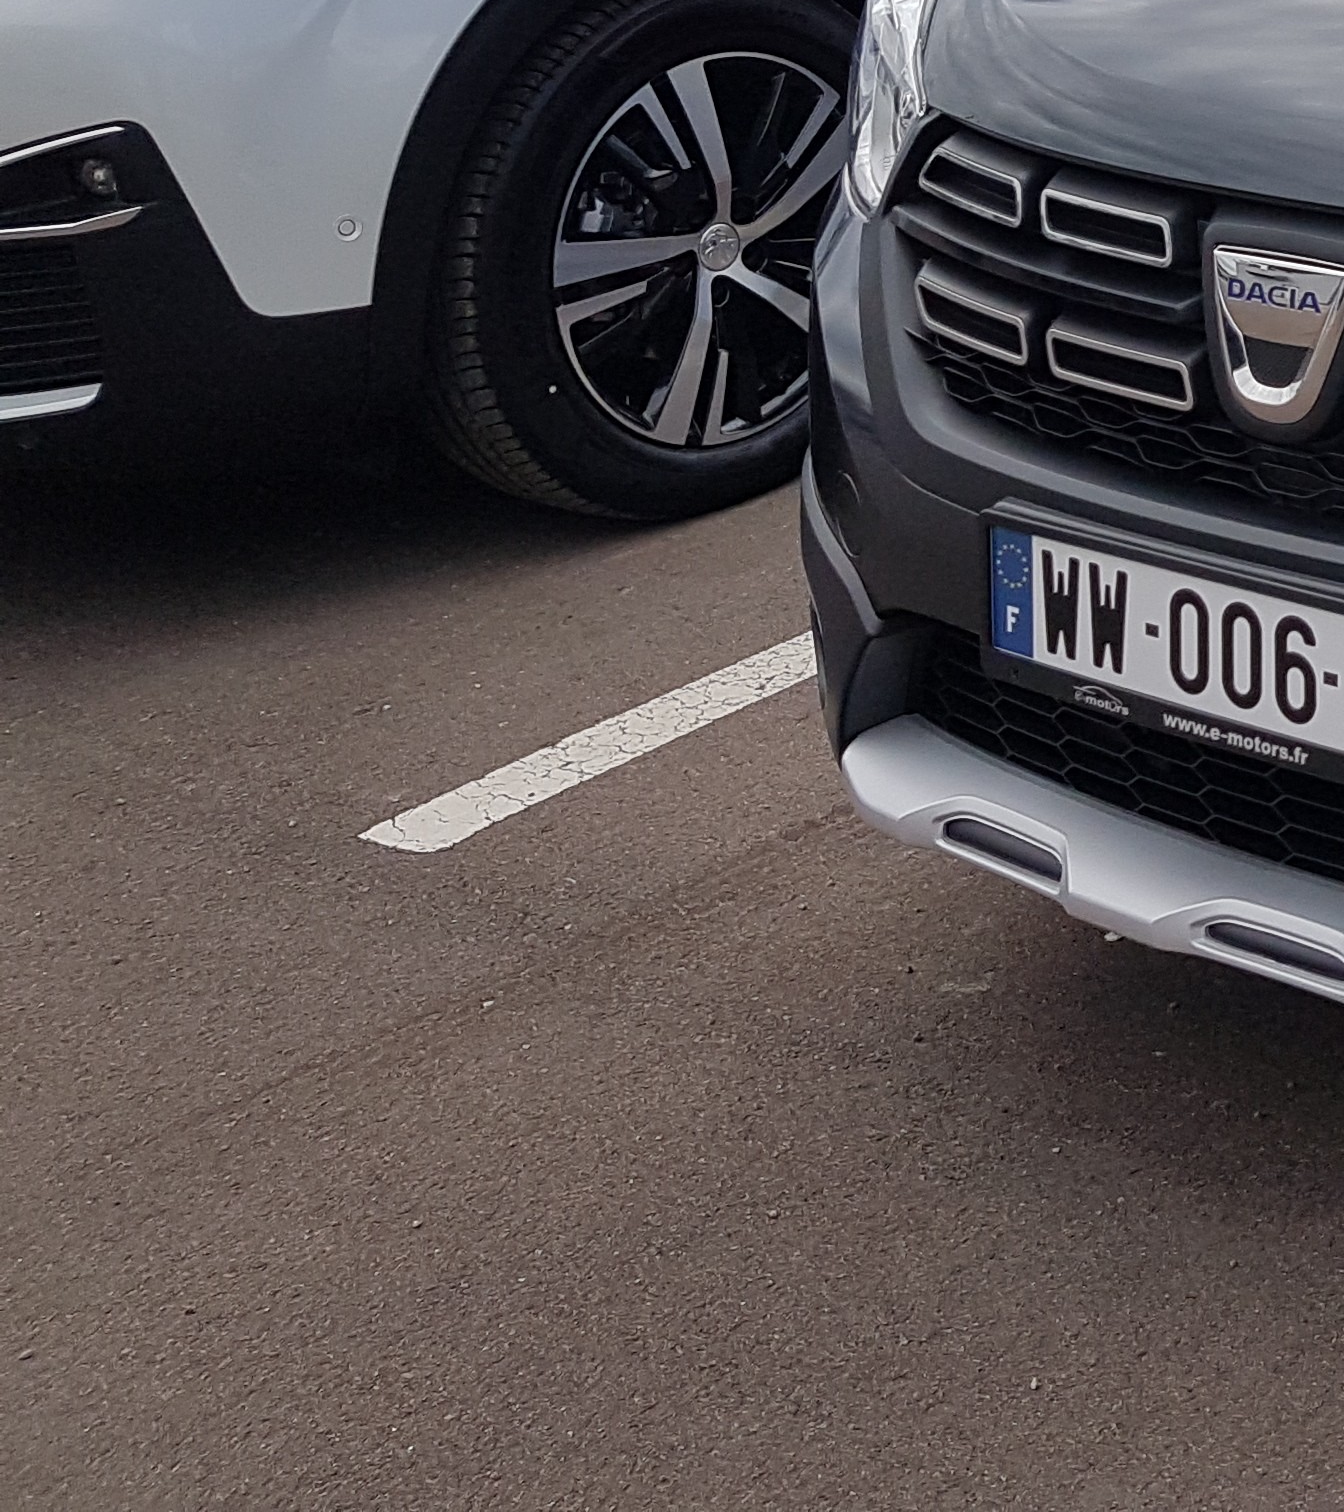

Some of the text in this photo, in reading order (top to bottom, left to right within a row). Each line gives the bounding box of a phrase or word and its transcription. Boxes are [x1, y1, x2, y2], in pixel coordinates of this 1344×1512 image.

[1227, 277, 1320, 314] DACIA
[1006, 605, 1020, 633] F
[1163, 713, 1310, 765] www.e-motors.fr
